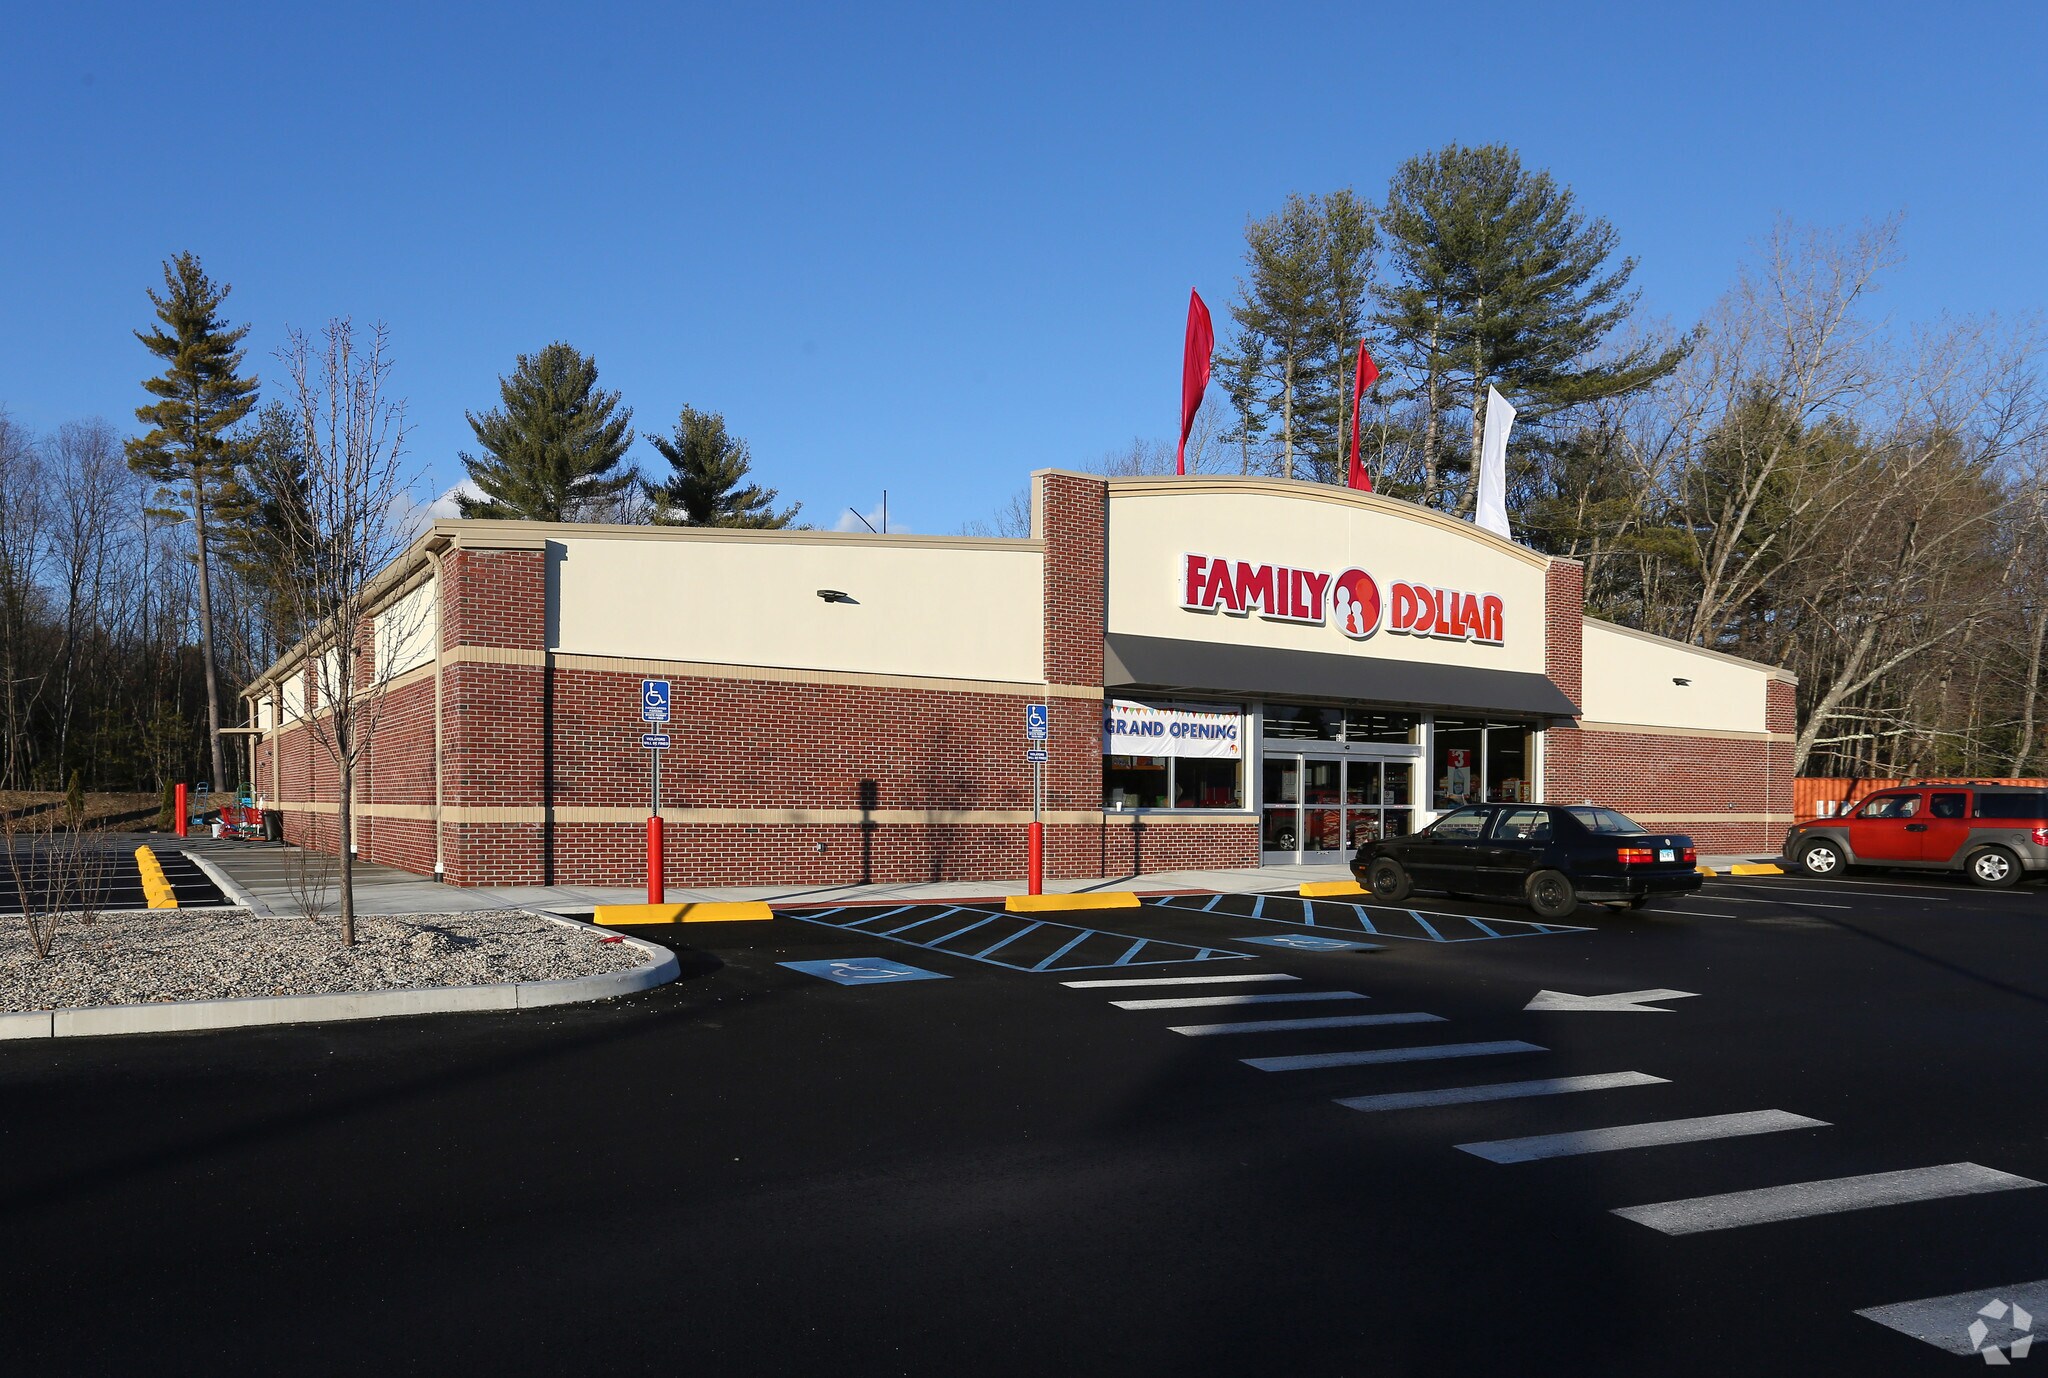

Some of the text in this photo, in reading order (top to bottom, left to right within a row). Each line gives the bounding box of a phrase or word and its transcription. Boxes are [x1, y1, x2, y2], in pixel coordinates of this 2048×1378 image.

[1184, 553, 1504, 642] FAMILY DOLLAR
[1104, 718, 1238, 740] GRAND OPENING
